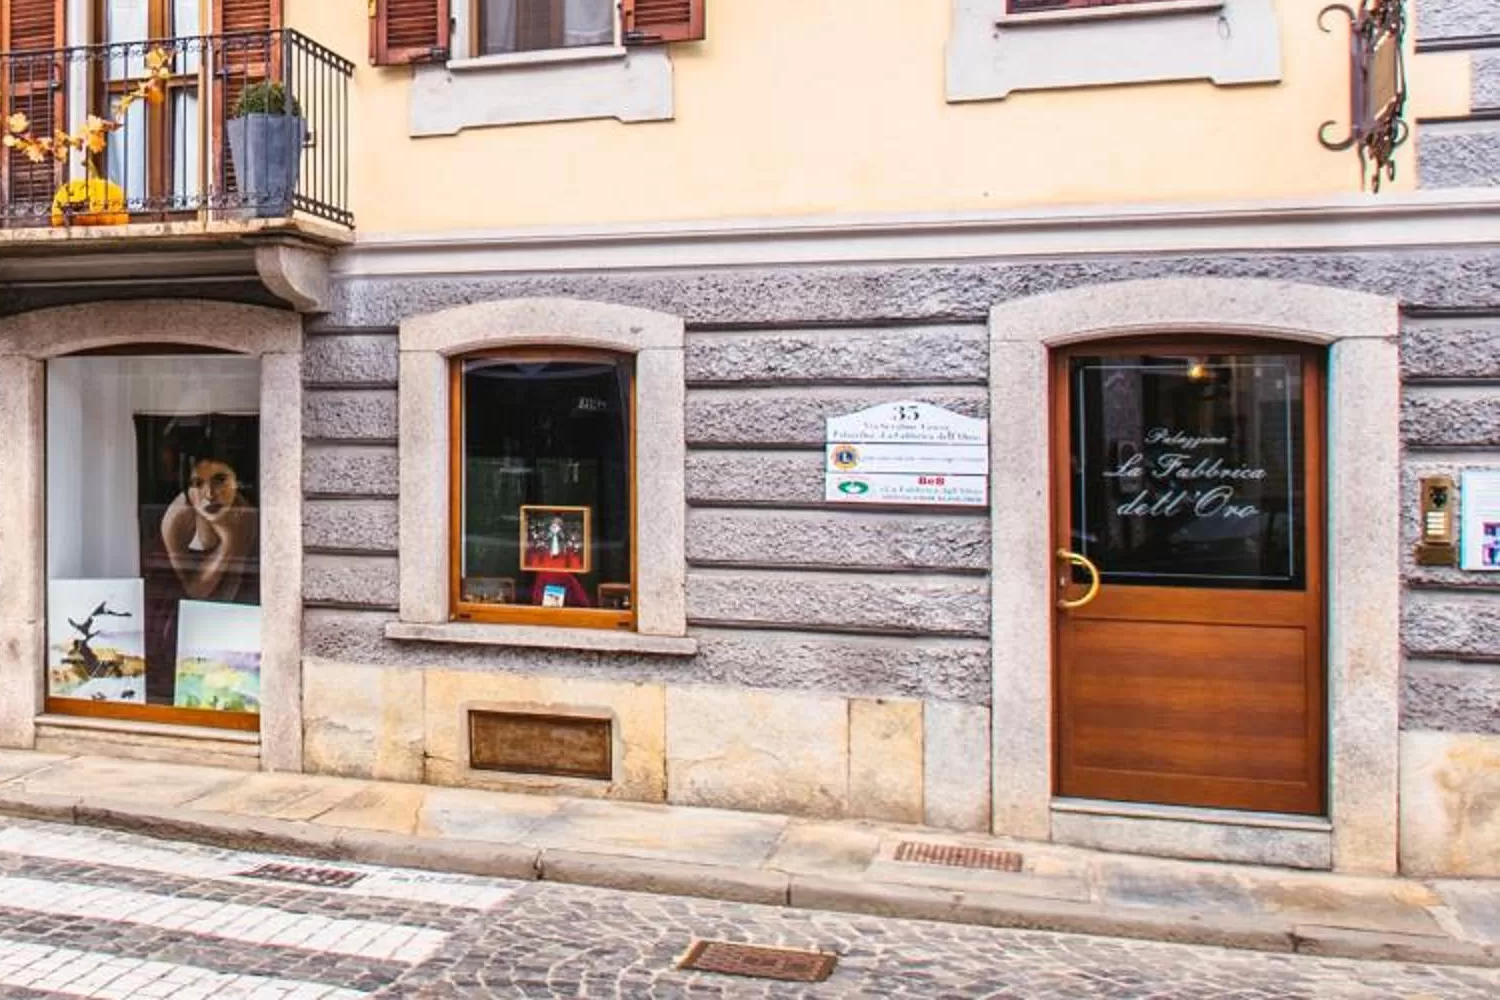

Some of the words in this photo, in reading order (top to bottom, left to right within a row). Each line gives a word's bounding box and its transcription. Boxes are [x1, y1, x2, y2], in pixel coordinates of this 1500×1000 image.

[1102, 453, 1143, 477] La
[1152, 453, 1266, 480] Fabbrica
[1116, 485, 1260, 518] dell'Oro
